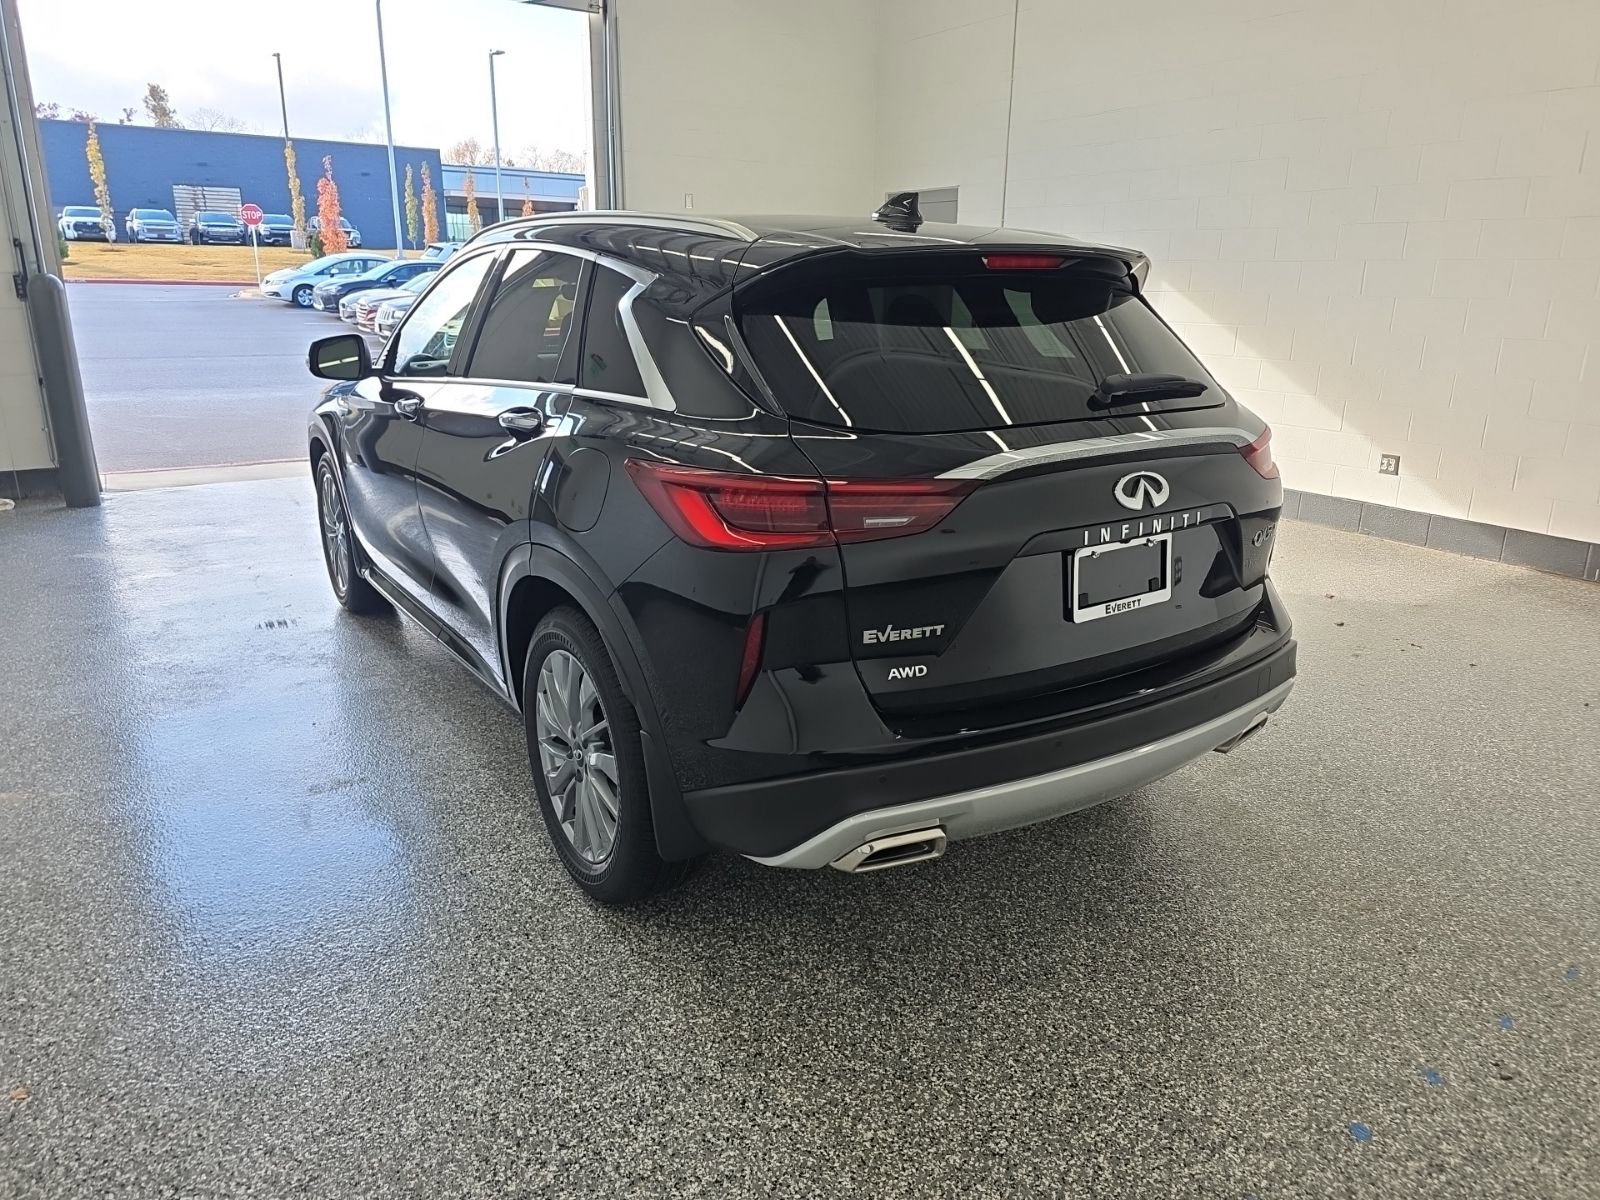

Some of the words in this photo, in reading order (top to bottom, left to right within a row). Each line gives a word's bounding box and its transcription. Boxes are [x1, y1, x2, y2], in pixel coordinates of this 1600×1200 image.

[242, 210, 262, 220] STOP
[1084, 511, 1201, 545] INFINITI
[1105, 598, 1142, 614] EVERETT
[862, 624, 945, 644] EVERETT
[887, 664, 928, 681] AWD
